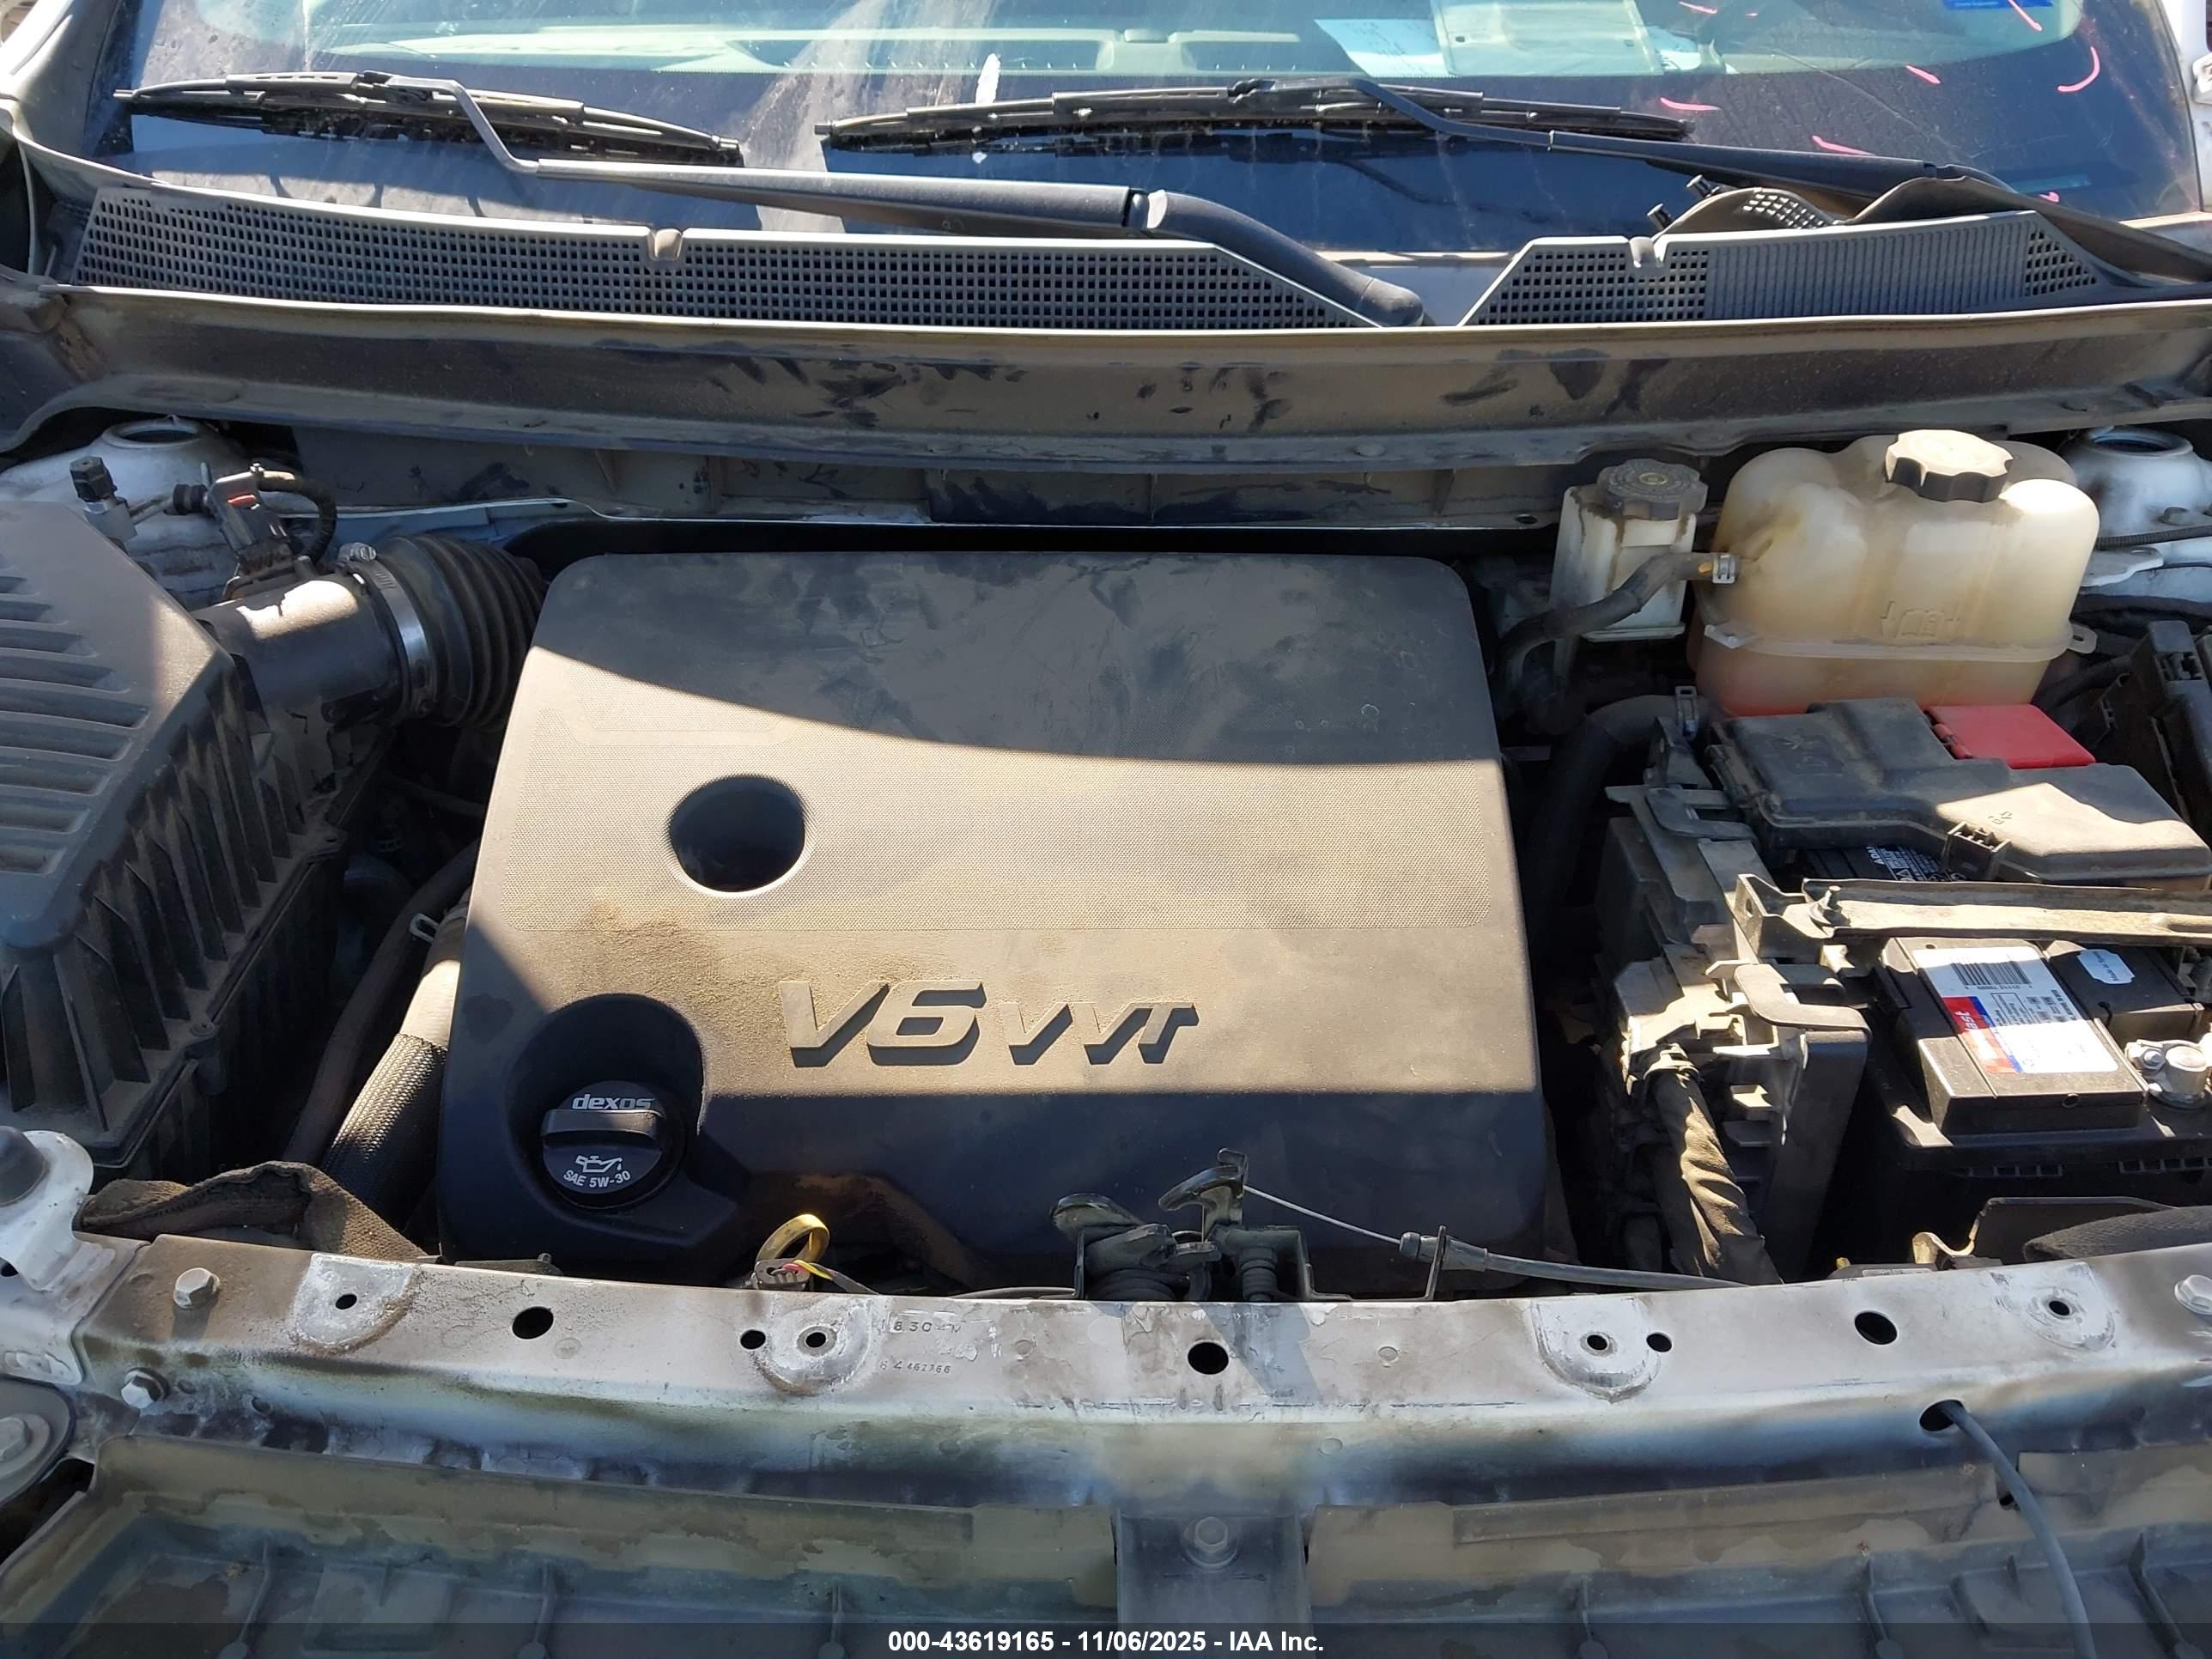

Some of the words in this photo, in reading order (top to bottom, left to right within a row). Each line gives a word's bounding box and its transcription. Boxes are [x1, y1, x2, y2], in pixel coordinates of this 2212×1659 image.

[778, 980, 986, 1065] V6
[998, 1001, 1199, 1064] VVT
[572, 1094, 655, 1109] dexos
[563, 1170, 586, 1186] SAE
[589, 1170, 631, 1188] 5W-30
